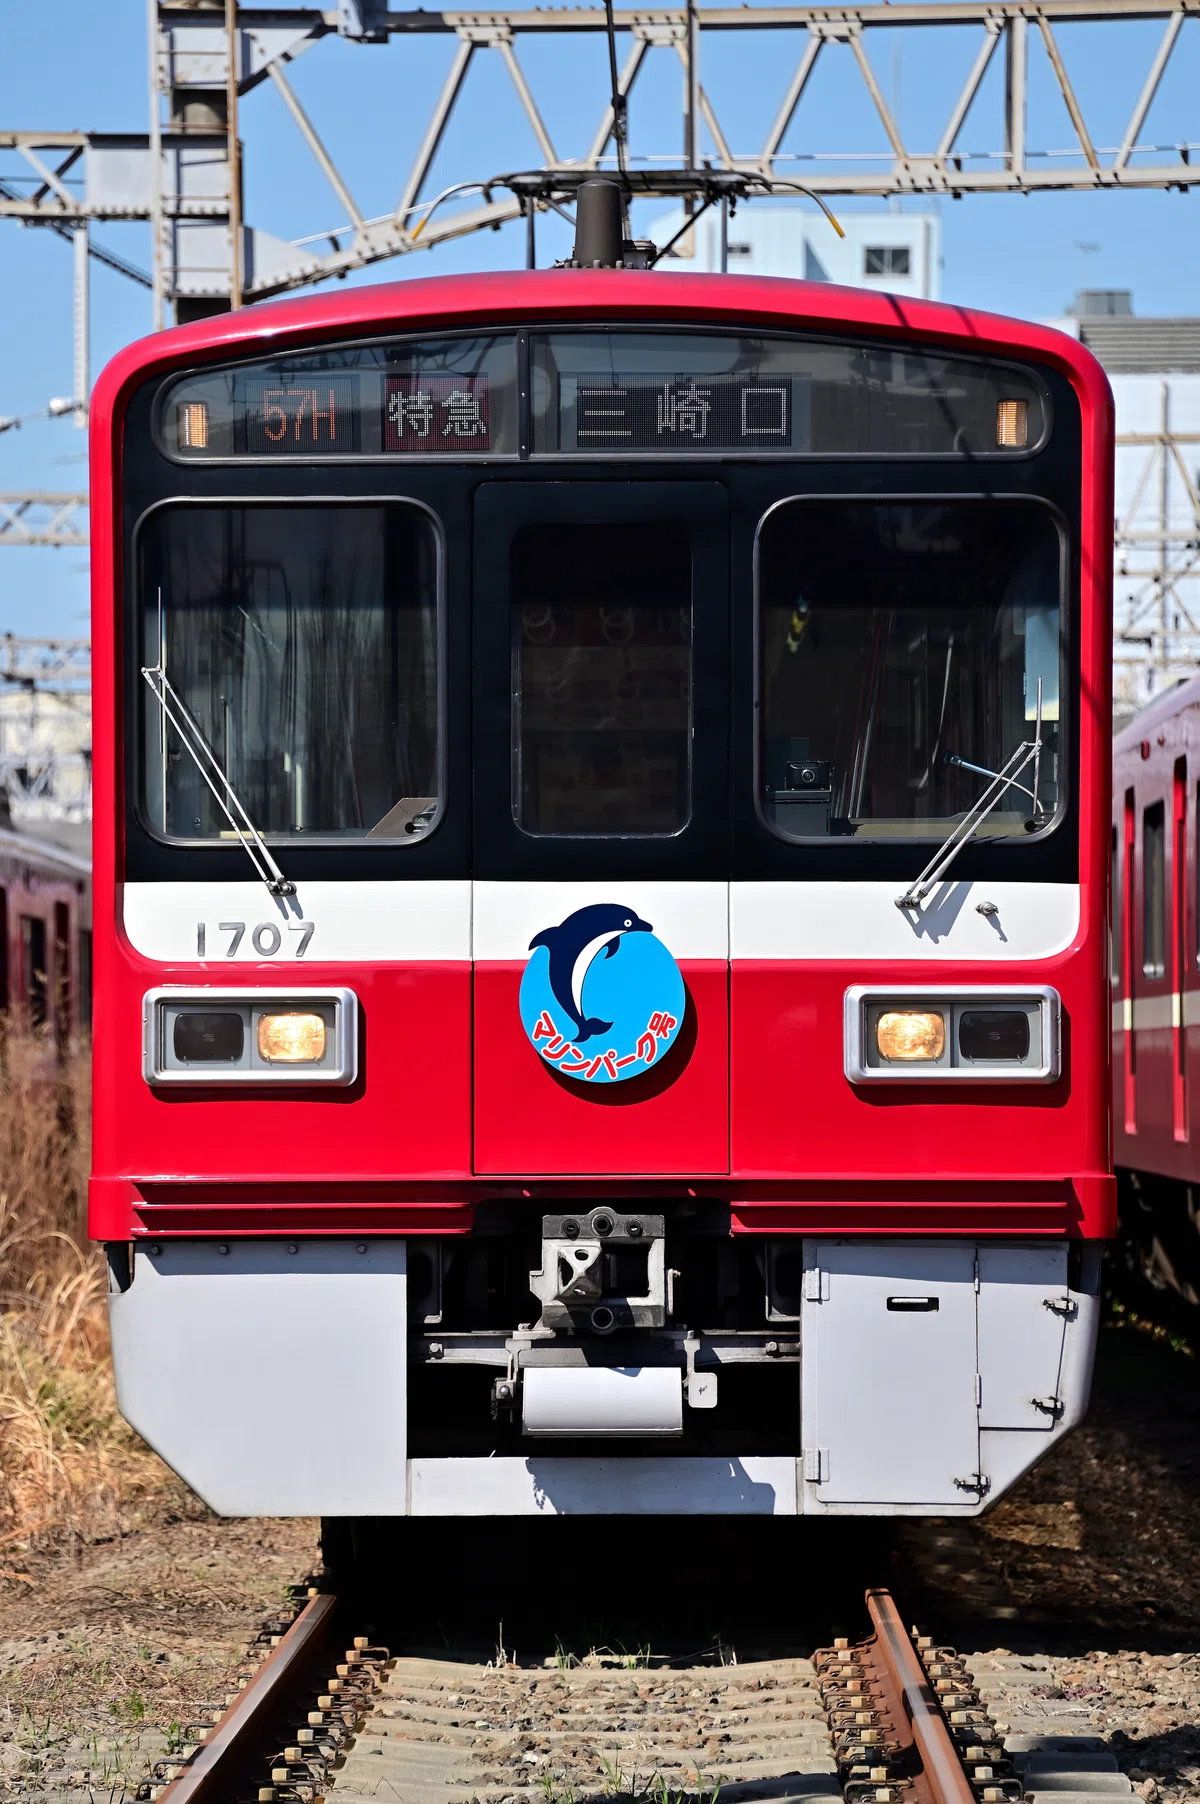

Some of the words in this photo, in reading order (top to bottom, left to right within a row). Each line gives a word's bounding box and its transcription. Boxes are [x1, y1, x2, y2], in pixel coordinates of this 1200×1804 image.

[263, 389, 336, 441] 57H
[388, 390, 487, 437] 特急
[577, 383, 787, 438] 三崎口
[197, 921, 316, 957] 1707
[532, 1010, 677, 1079] マリンパーク号
